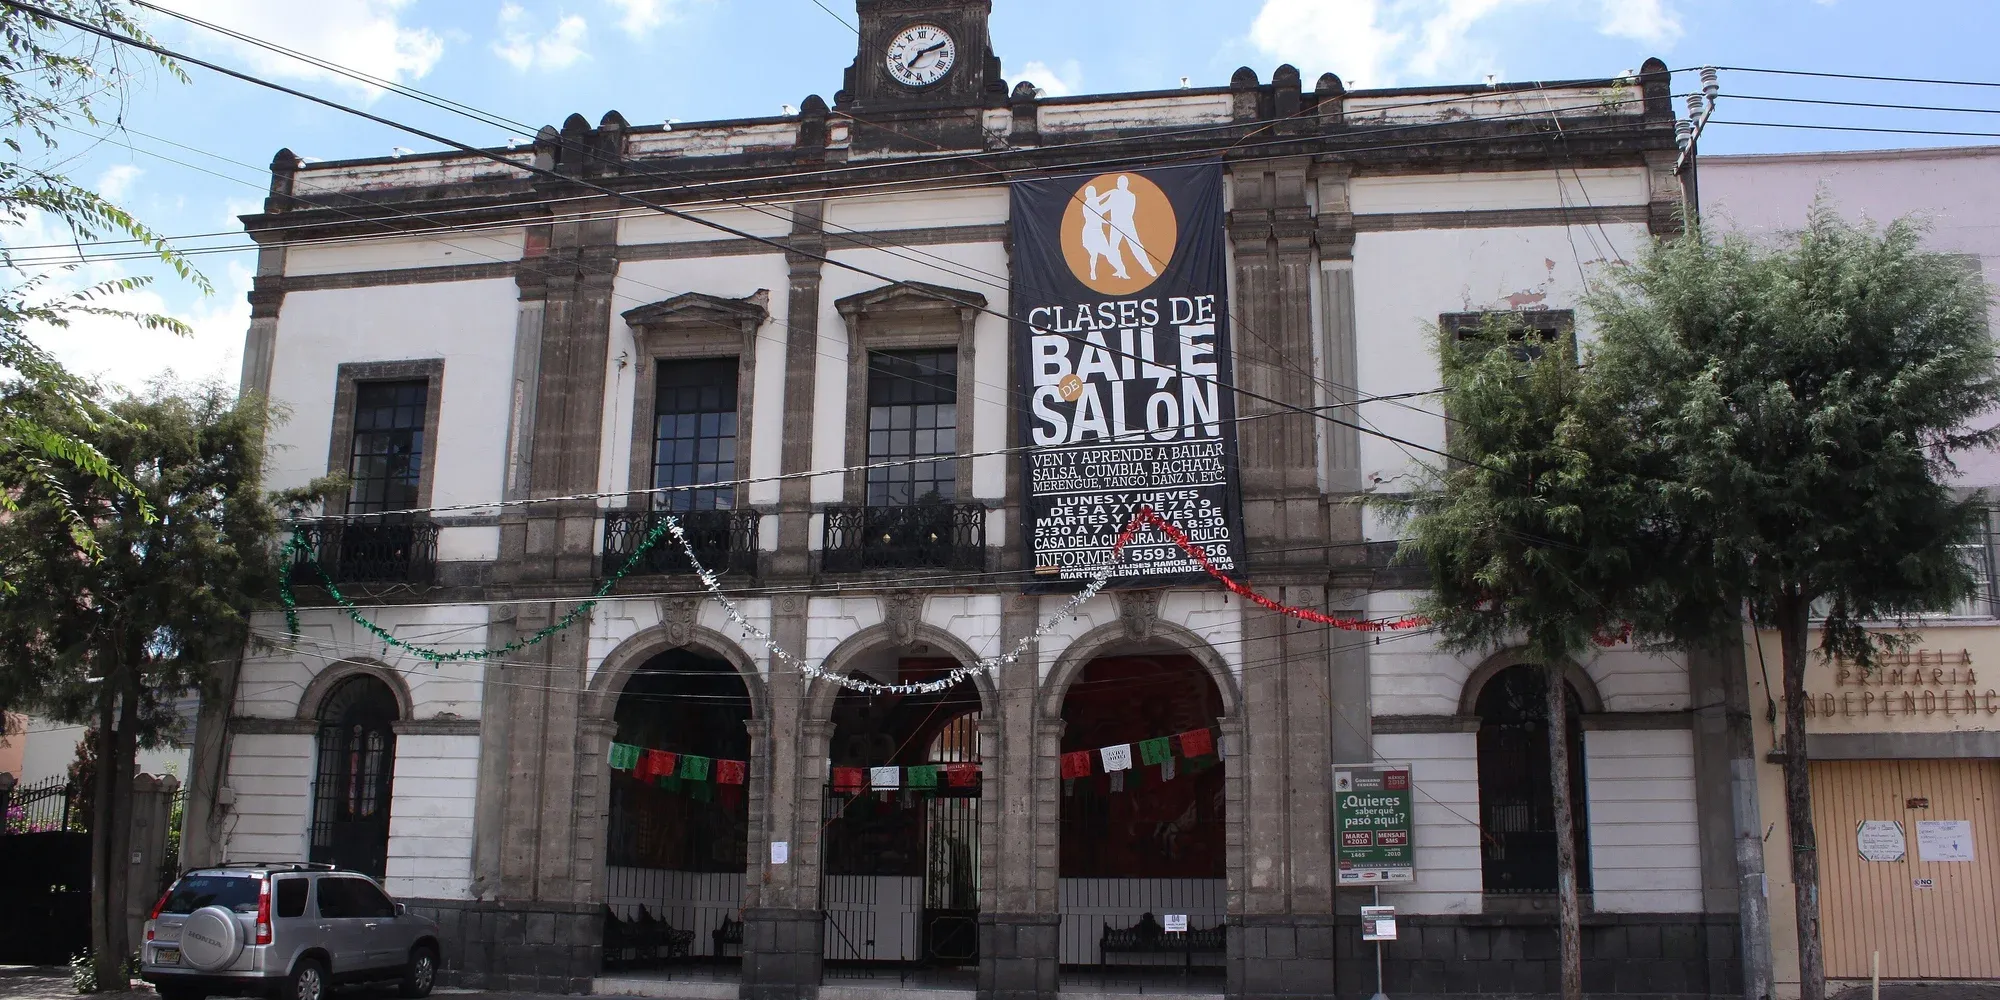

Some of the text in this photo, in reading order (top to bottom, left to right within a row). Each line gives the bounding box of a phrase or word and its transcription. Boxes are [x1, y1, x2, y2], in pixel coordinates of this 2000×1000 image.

[1028, 295, 1216, 334] CLASES DE
[1031, 323, 1218, 387] BAILE
[1061, 378, 1080, 397] DE
[1032, 443, 1224, 467] VEN Y APRENDE A BAILAR
[1033, 457, 1225, 481] SALSA, CUMBIA, BACHATA,
[1033, 478, 1101, 492] MERENGUE,
[1104, 475, 1149, 488] TANGO,
[1201, 470, 1226, 482] ETC.
[1050, 507, 1074, 517] DE
[1079, 505, 1088, 515] 5
[1093, 505, 1106, 514] A
[1110, 504, 1121, 514] 7
[1124, 503, 1136, 513] Y
[1168, 501, 1179, 510] 7
[1183, 500, 1196, 509] A
[1200, 499, 1211, 508] 9
[1057, 490, 1199, 507] LUNES Y JUEVES
[1036, 514, 1109, 527] MARTES
[1112, 513, 1124, 523] Y
[1198, 507, 1222, 518] DE
[1035, 526, 1071, 537] 5:30
[1076, 525, 1088, 535] A
[1092, 524, 1103, 534] 7
[1111, 523, 1122, 533] Y
[1187, 517, 1225, 528] 8:30
[1034, 536, 1066, 549] CASA
[1068, 535, 1099, 548] DELA
[1191, 526, 1229, 541] RULFO
[1143, 564, 1205, 575] HERNANDEZ
[1153, 559, 1187, 568] RAMOS
[1840, 668, 1976, 686] PRIMARIA
[1802, 688, 1997, 718] NDEPENDENC
[1342, 794, 1400, 809] ¿Quieres
[1355, 806, 1394, 816] saber qué
[1345, 812, 1405, 828] pasó aquí?
[188, 931, 222, 948] HONDA
